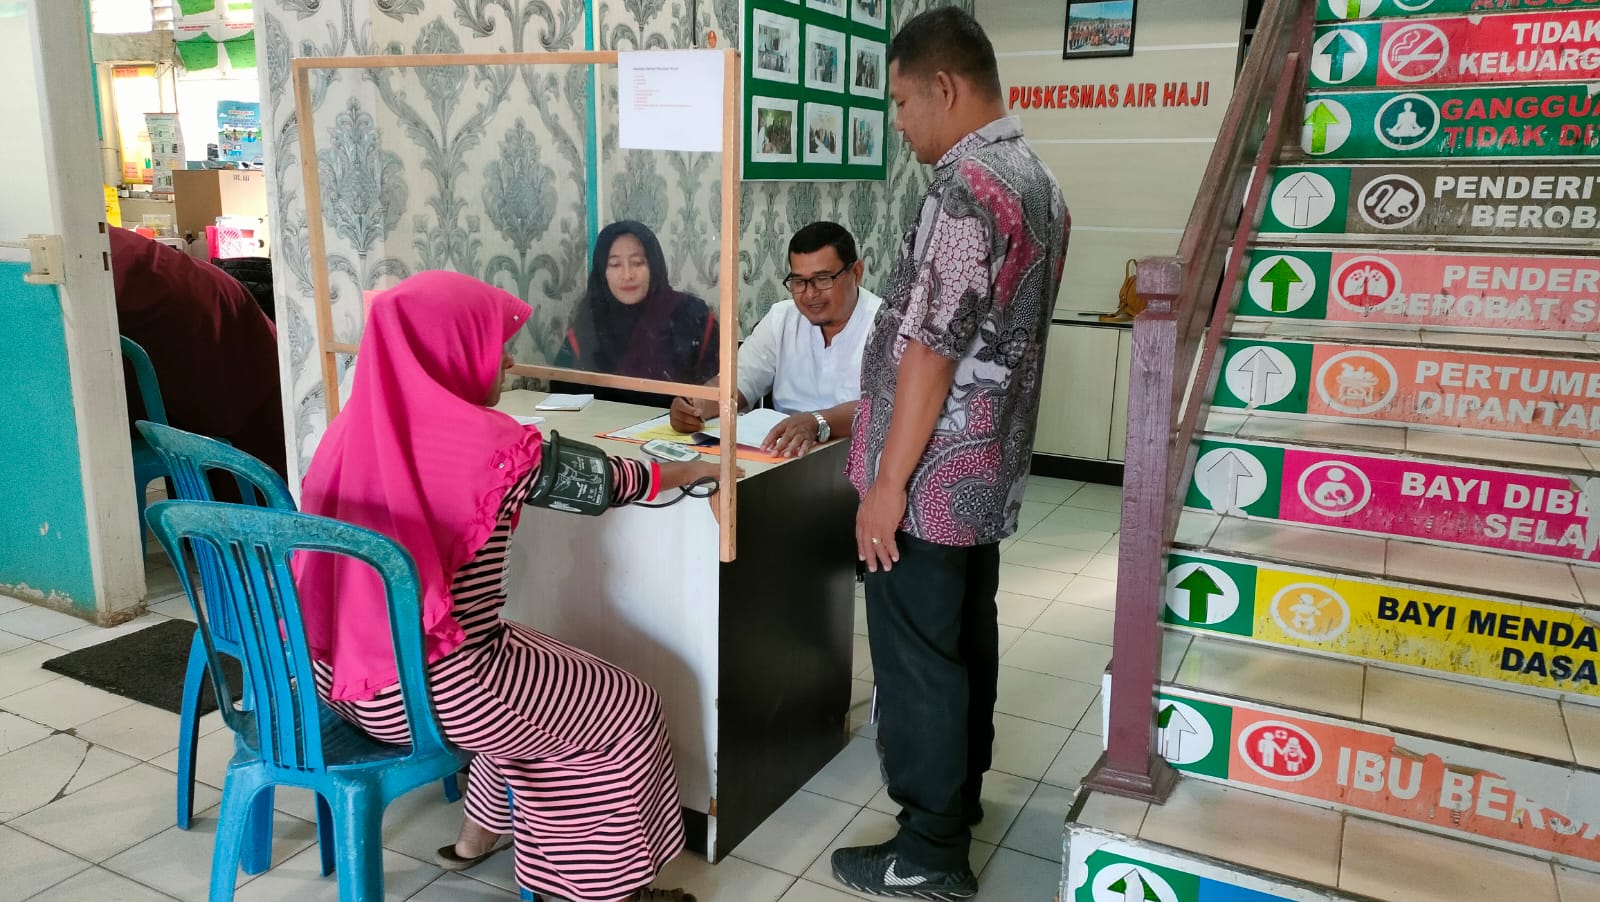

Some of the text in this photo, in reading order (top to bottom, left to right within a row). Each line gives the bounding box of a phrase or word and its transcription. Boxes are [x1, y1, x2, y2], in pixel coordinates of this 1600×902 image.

[1512, 19, 1600, 45] TIDAK
[1008, 81, 1209, 110] PUSKESMAS AIR HAJI
[1442, 124, 1600, 148] TIDAK DI
[1434, 175, 1600, 200] PENDERI
[1471, 205, 1600, 229] BEROB
[1442, 265, 1600, 293] PENDER
[1383, 293, 1560, 321] BEROBAT
[1401, 472, 1490, 505] BAYI
[1377, 596, 1599, 652] BAYI MENDA
[1500, 646, 1599, 685] DASA
[1336, 746, 1423, 800] IBU
